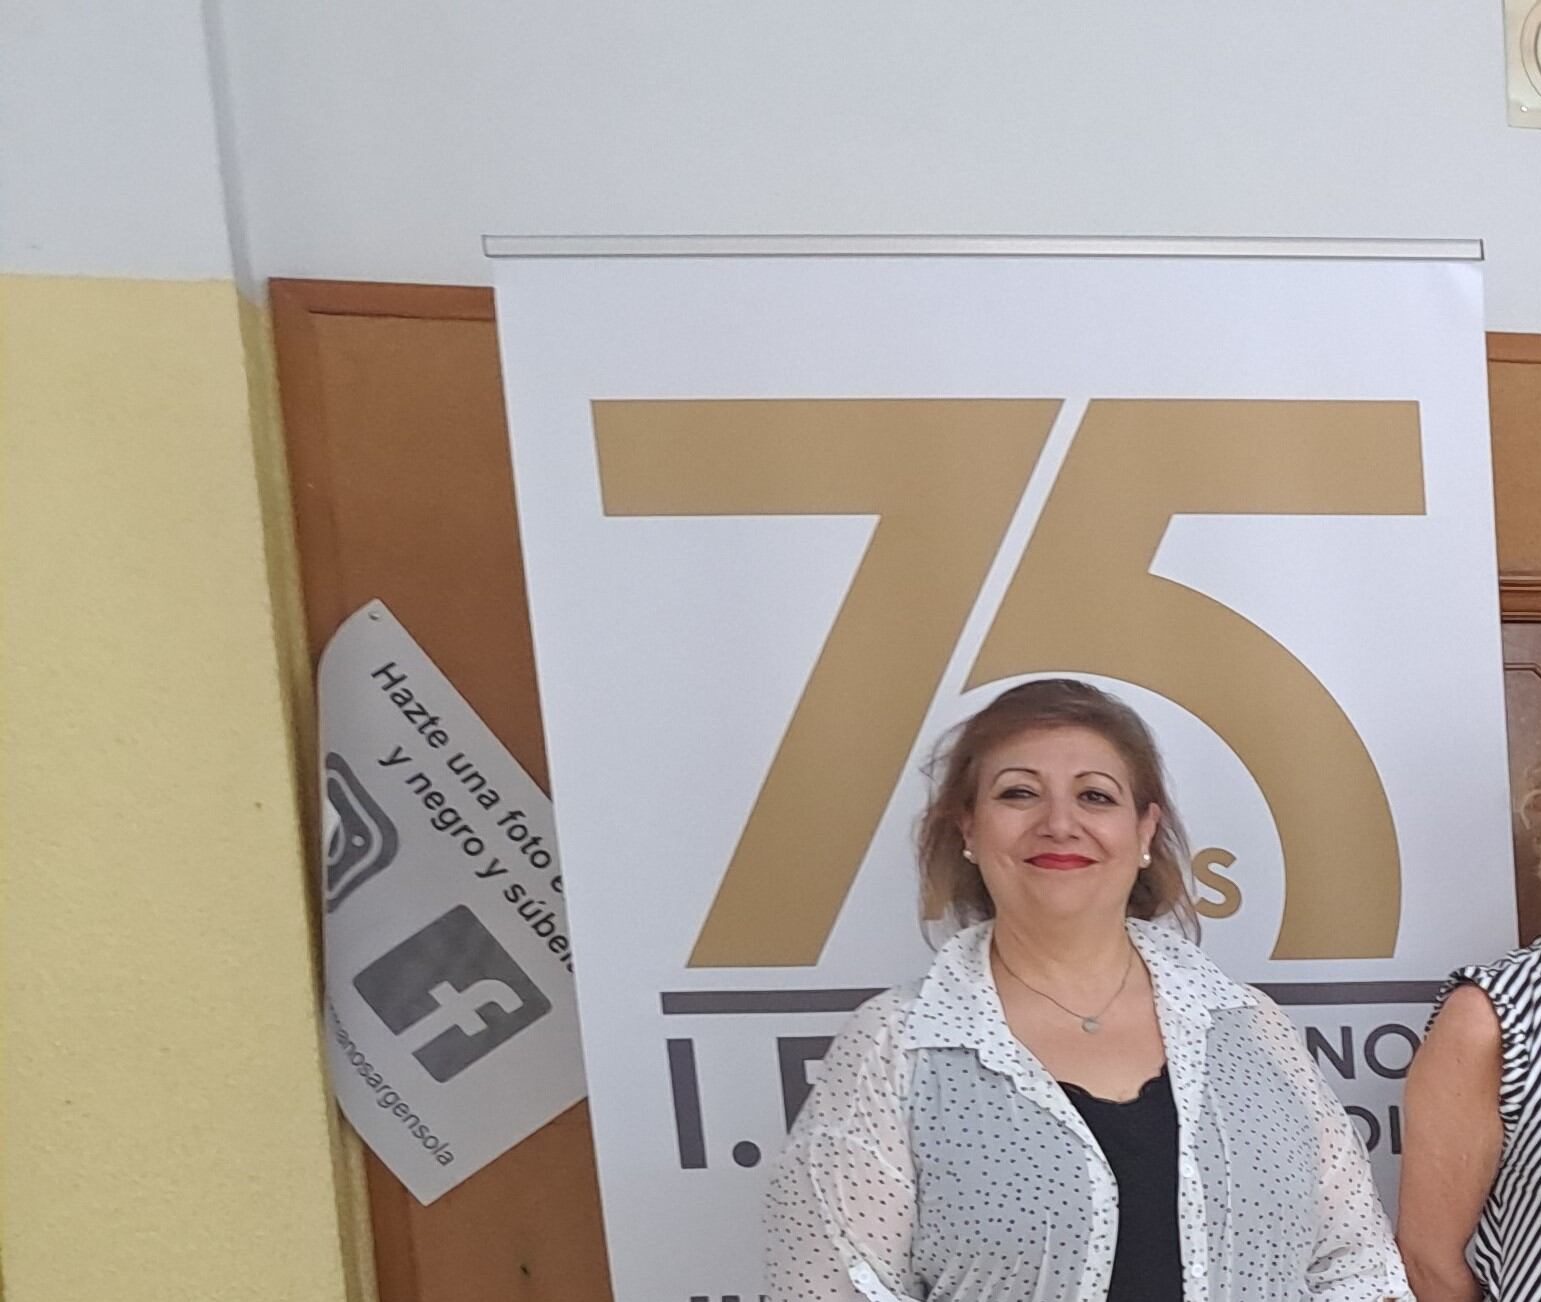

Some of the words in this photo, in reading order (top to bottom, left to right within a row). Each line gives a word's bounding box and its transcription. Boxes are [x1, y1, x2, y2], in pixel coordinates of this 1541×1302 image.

[371, 661, 450, 749] Hazte
[447, 750, 503, 811] una
[496, 809, 553, 872] foto
[589, 398, 1428, 969] 75
[377, 744, 412, 768] y
[404, 771, 485, 859] negro
[475, 856, 507, 880] y
